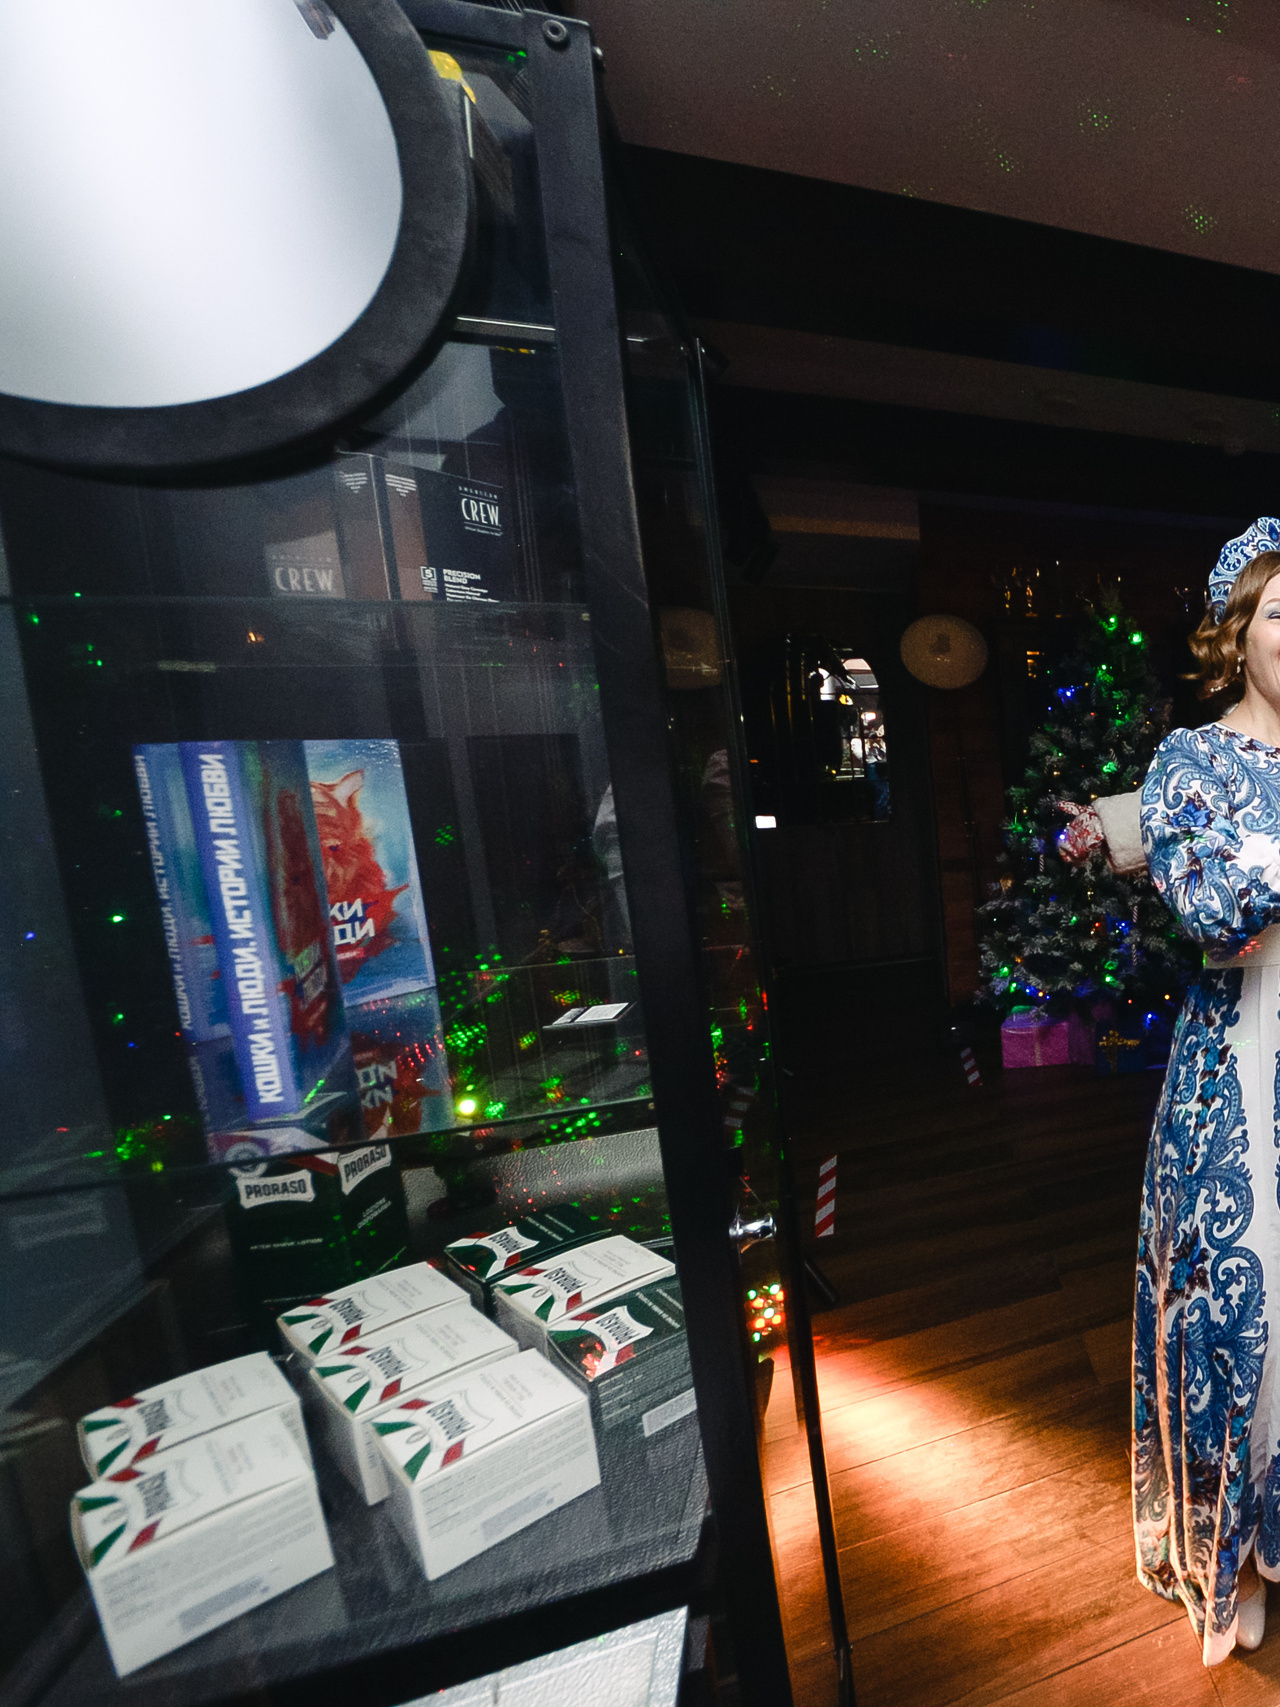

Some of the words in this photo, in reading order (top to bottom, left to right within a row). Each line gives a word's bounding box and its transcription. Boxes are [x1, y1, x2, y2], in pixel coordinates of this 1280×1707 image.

[461, 497, 500, 526] CREW
[274, 566, 334, 592] CREW
[442, 568, 482, 581] PRECISION
[444, 575, 469, 585] BLEND
[198, 753, 238, 836] ЛЮБВИ
[145, 820, 170, 900] ИСТОРИИ
[212, 838, 255, 940] ИСТОРИИ
[173, 974, 193, 1031] КОШКИ
[247, 1032, 285, 1104] КОШКИ
[343, 1144, 387, 1183] PRORASO
[243, 1178, 308, 1200] PRORASO
[542, 1266, 587, 1295] PRORASO
[594, 1312, 640, 1345] PRORASO
[425, 1399, 475, 1442] PRORASO
